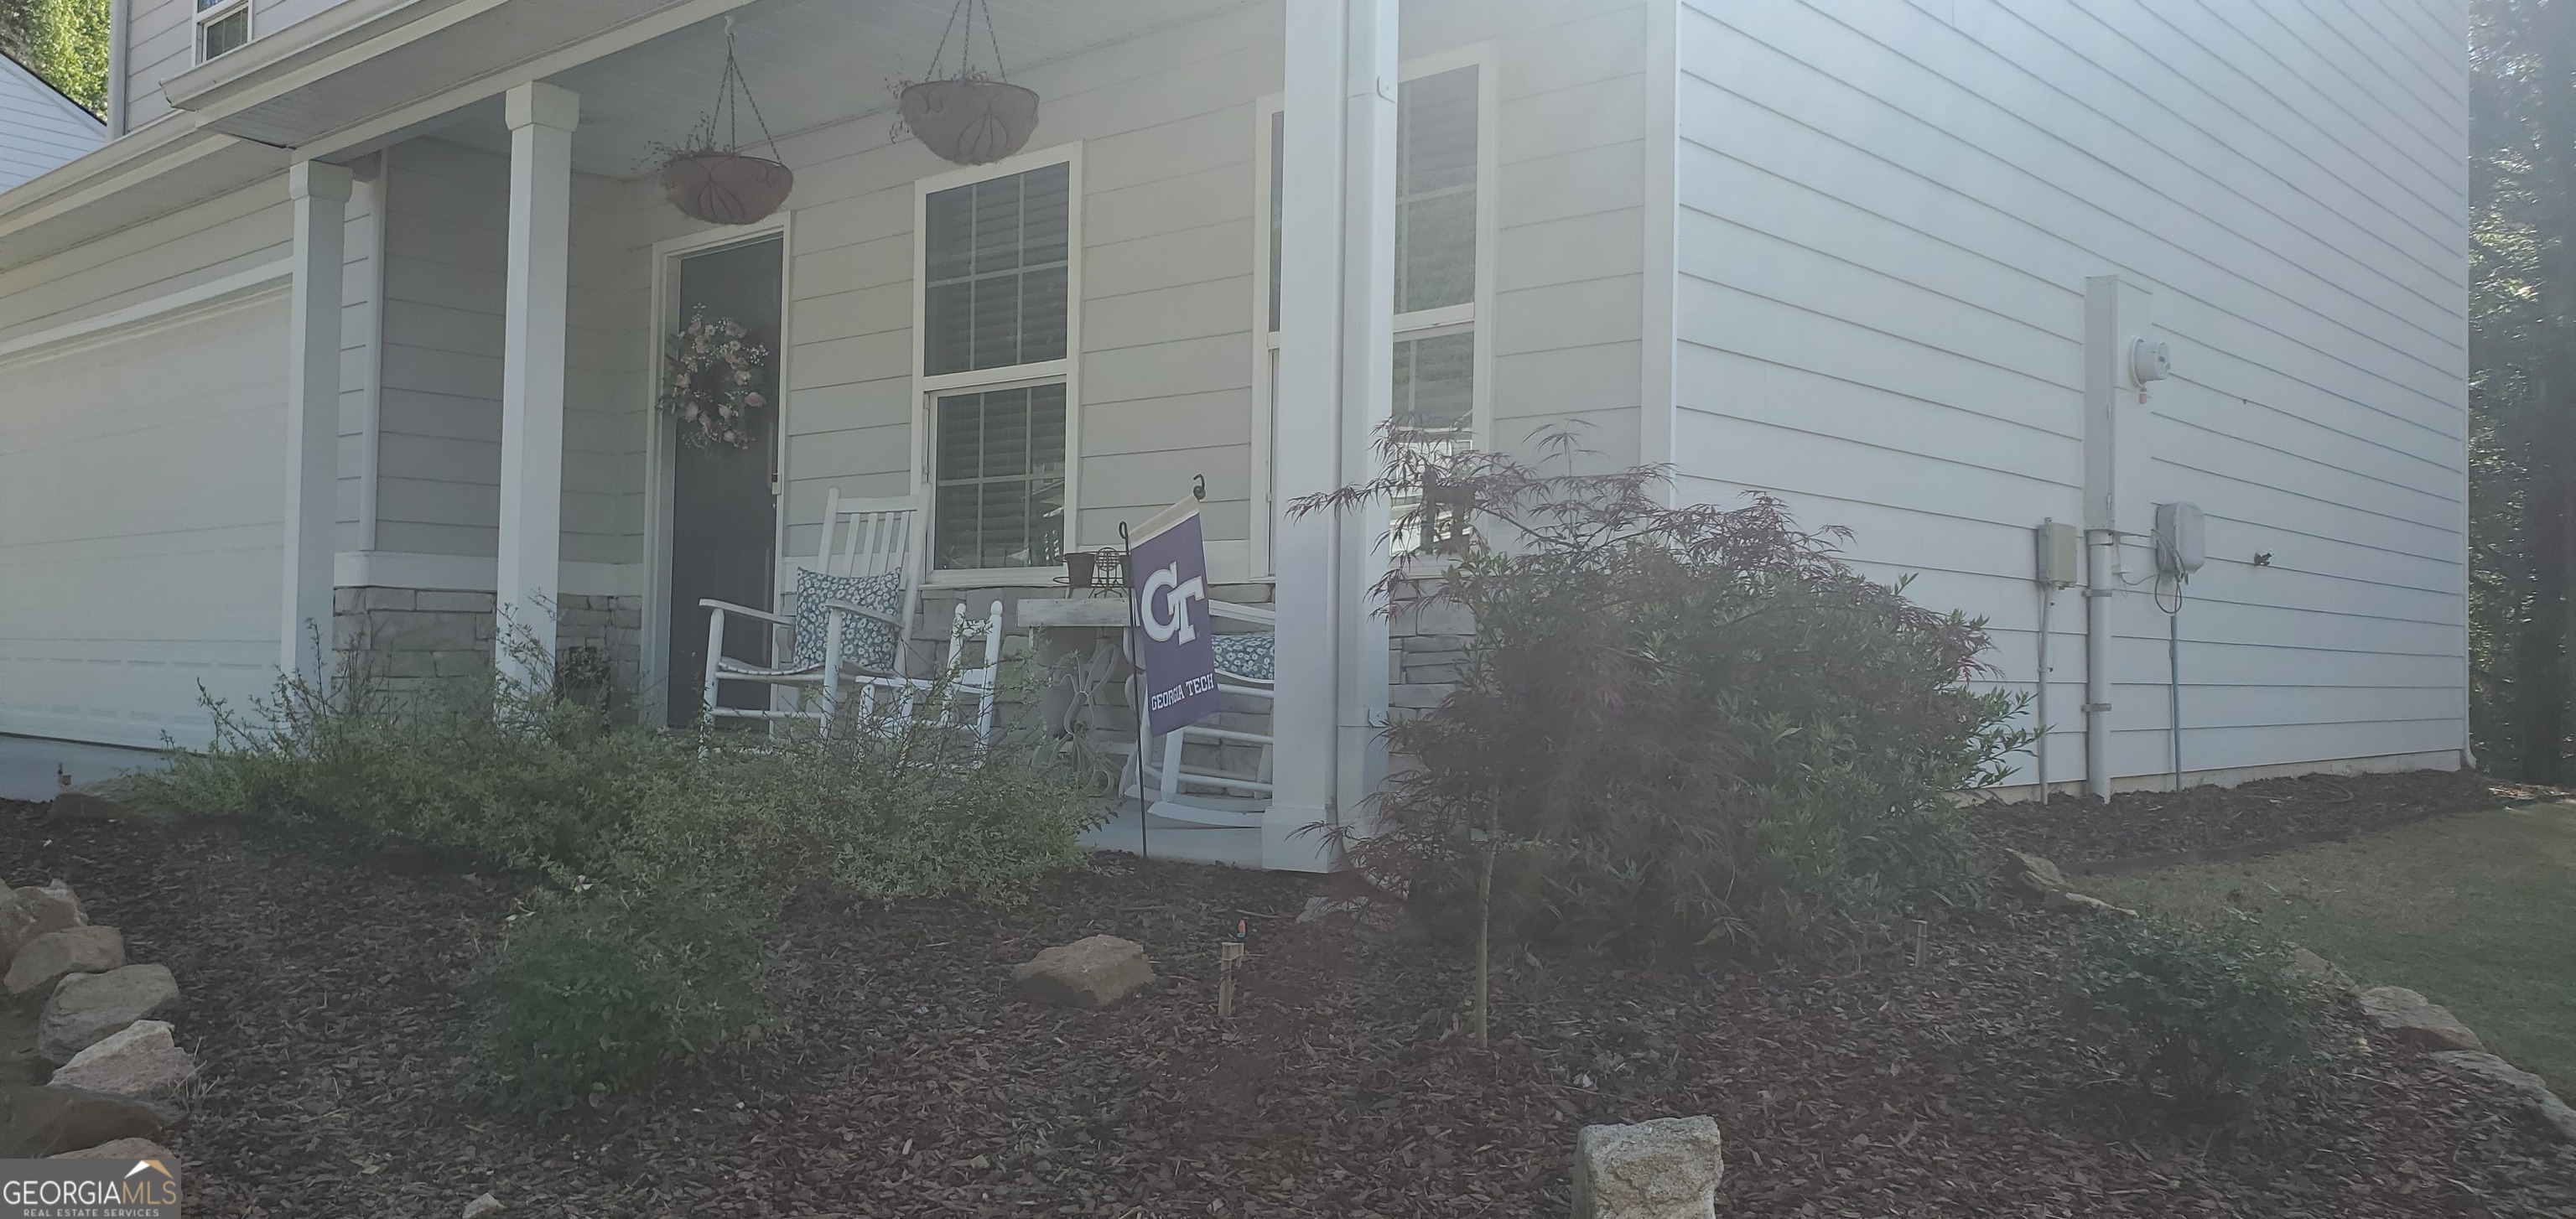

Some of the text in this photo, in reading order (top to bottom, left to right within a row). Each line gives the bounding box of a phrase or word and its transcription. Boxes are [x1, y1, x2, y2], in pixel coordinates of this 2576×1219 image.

[1140, 561, 1205, 646] GT
[1151, 672, 1214, 711] GEORGIA TECH
